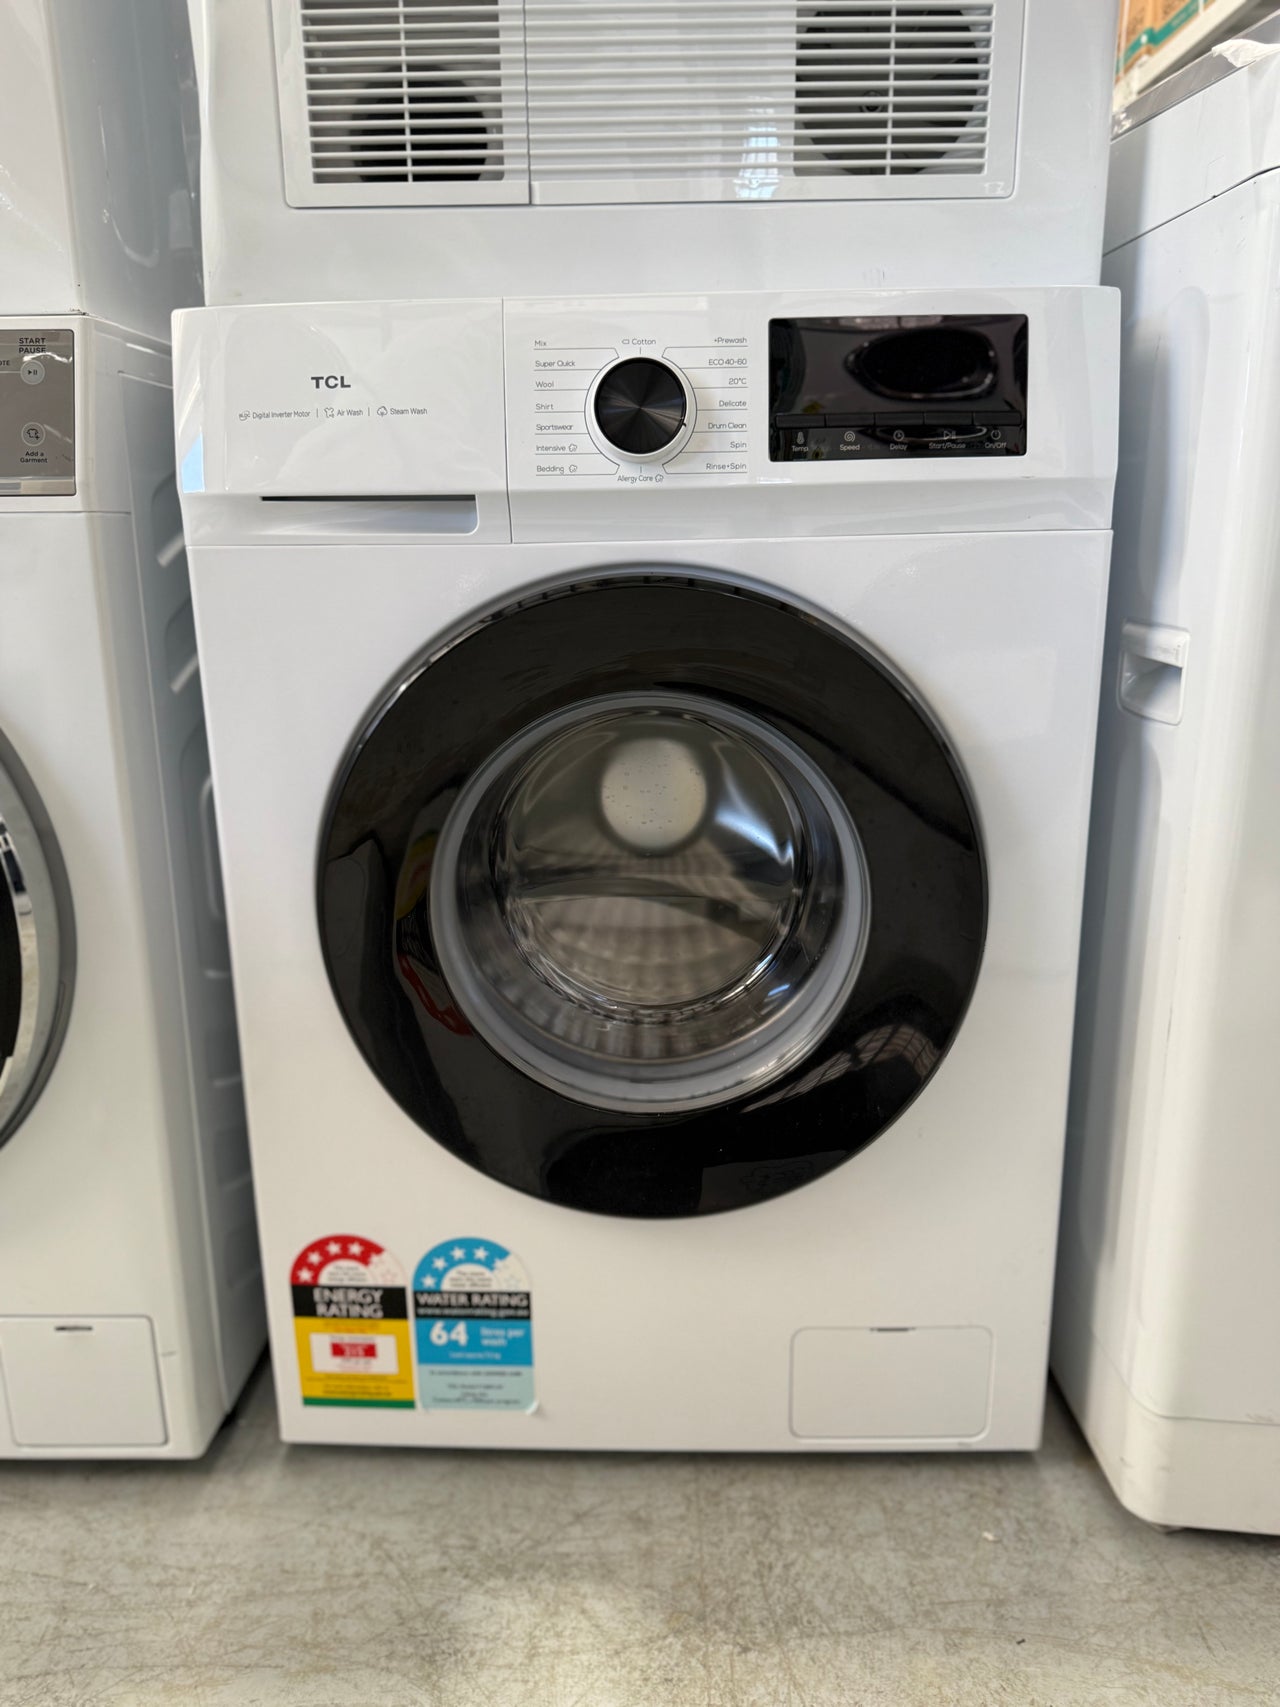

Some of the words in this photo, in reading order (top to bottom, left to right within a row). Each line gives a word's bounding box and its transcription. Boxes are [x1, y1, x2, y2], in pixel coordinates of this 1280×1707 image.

[535, 360, 556, 368] Super
[557, 359, 576, 367] Quick
[311, 375, 351, 389] TCL
[728, 377, 747, 385] 20°C
[252, 411, 270, 420] Digital
[293, 410, 311, 418] Motor
[337, 409, 345, 417] Air
[410, 407, 428, 415] Wash
[536, 424, 574, 432] Sportswear
[536, 444, 566, 452] Intensive
[730, 441, 747, 449] Spin
[792, 445, 809, 453] Temp
[890, 443, 907, 451] Delay
[928, 441, 966, 450] Start/Pause
[536, 465, 564, 474] Bedding
[706, 463, 747, 471] Rinse+Spin
[617, 475, 637, 483] Allergy
[313, 1288, 384, 1304] ENERGY
[417, 1293, 469, 1307] WATER
[471, 1294, 528, 1308] RATING
[317, 1303, 383, 1318] RATING
[430, 1322, 469, 1346] 64
